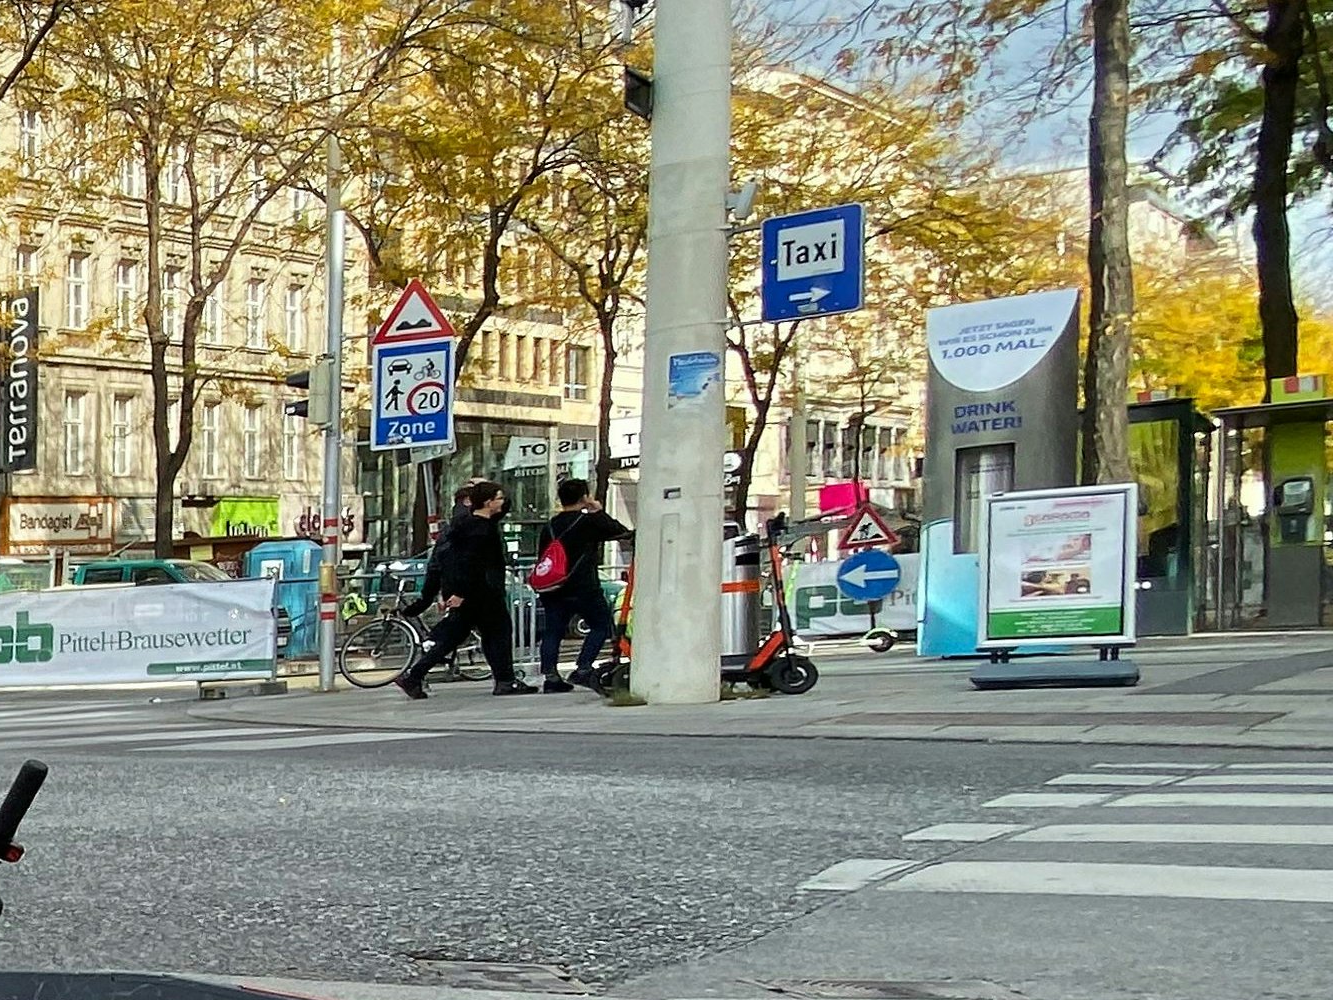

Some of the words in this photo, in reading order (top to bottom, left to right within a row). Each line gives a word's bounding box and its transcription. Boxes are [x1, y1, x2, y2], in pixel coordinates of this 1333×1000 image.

[782, 233, 838, 267] Taxi
[958, 323, 994, 335] JETZT
[995, 318, 1035, 329] SAGEN
[979, 330, 1022, 341] SCHON
[1024, 325, 1053, 336] ZUM
[942, 343, 991, 359] 1.000
[995, 338, 1046, 353] MAL:
[8, 297, 30, 464] Terranova
[418, 391, 440, 409] 20
[953, 401, 1015, 419] DRINK
[388, 420, 436, 436] Zone
[951, 416, 1023, 434] WATER!
[20, 512, 72, 533] Bandagist
[59, 625, 252, 653] Pittel+Brausewetter
